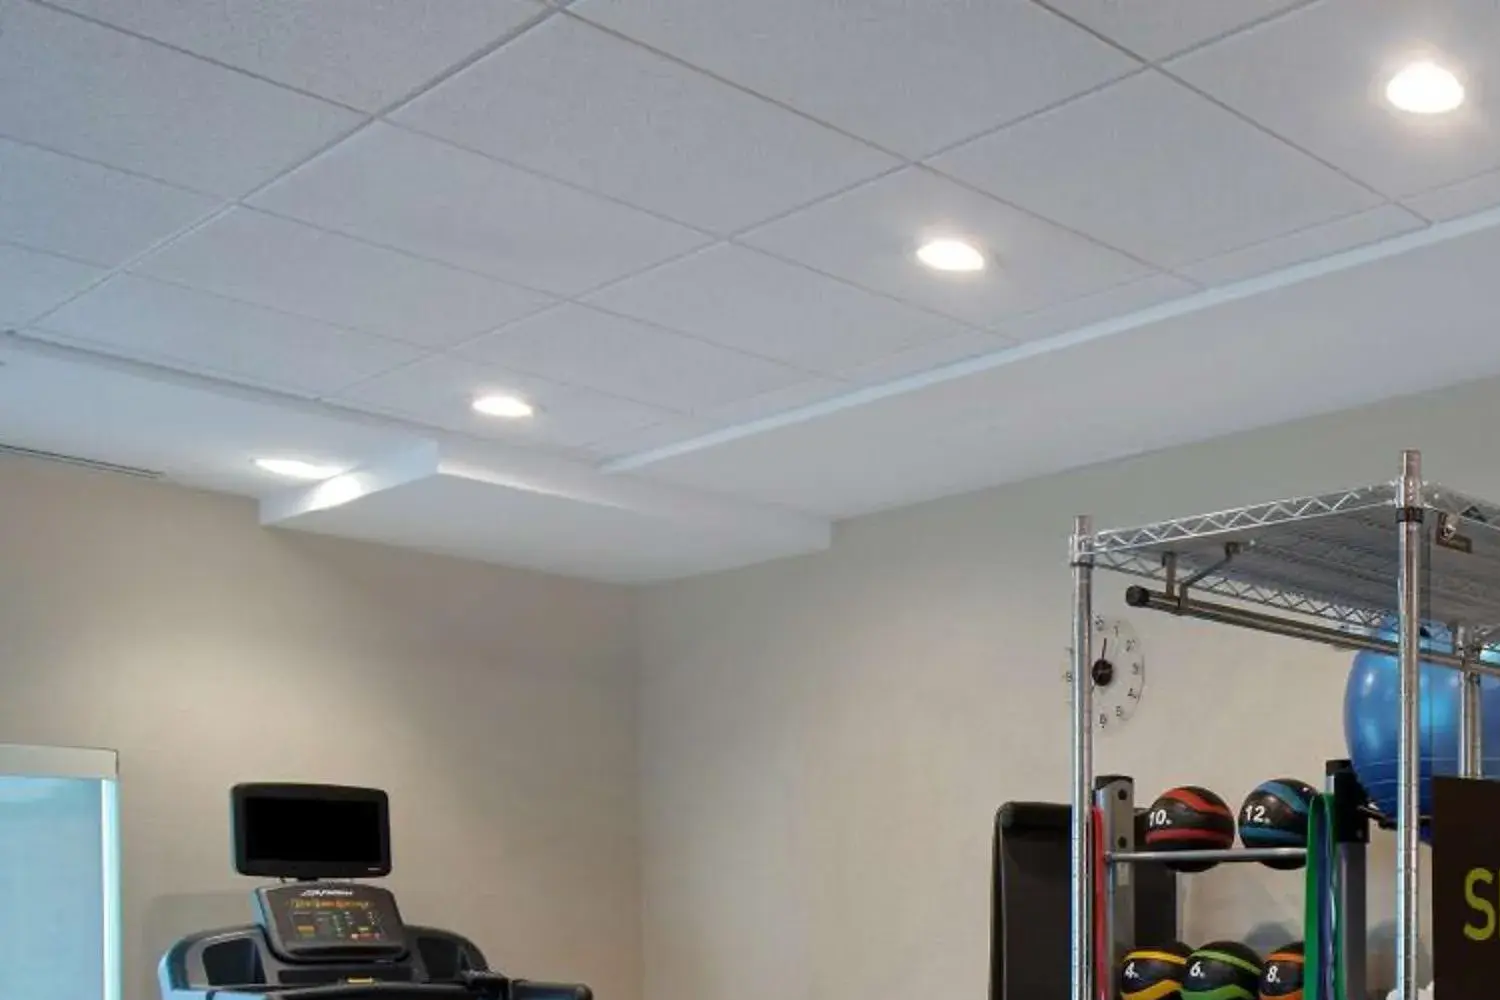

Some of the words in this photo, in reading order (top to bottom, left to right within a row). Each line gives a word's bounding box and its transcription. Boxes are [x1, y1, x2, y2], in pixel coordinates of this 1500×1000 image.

[1149, 808, 1168, 827] 10
[1244, 804, 1266, 823] 12
[1124, 962, 1137, 978] 4
[1189, 961, 1202, 978] 6
[1266, 965, 1279, 983] 8
